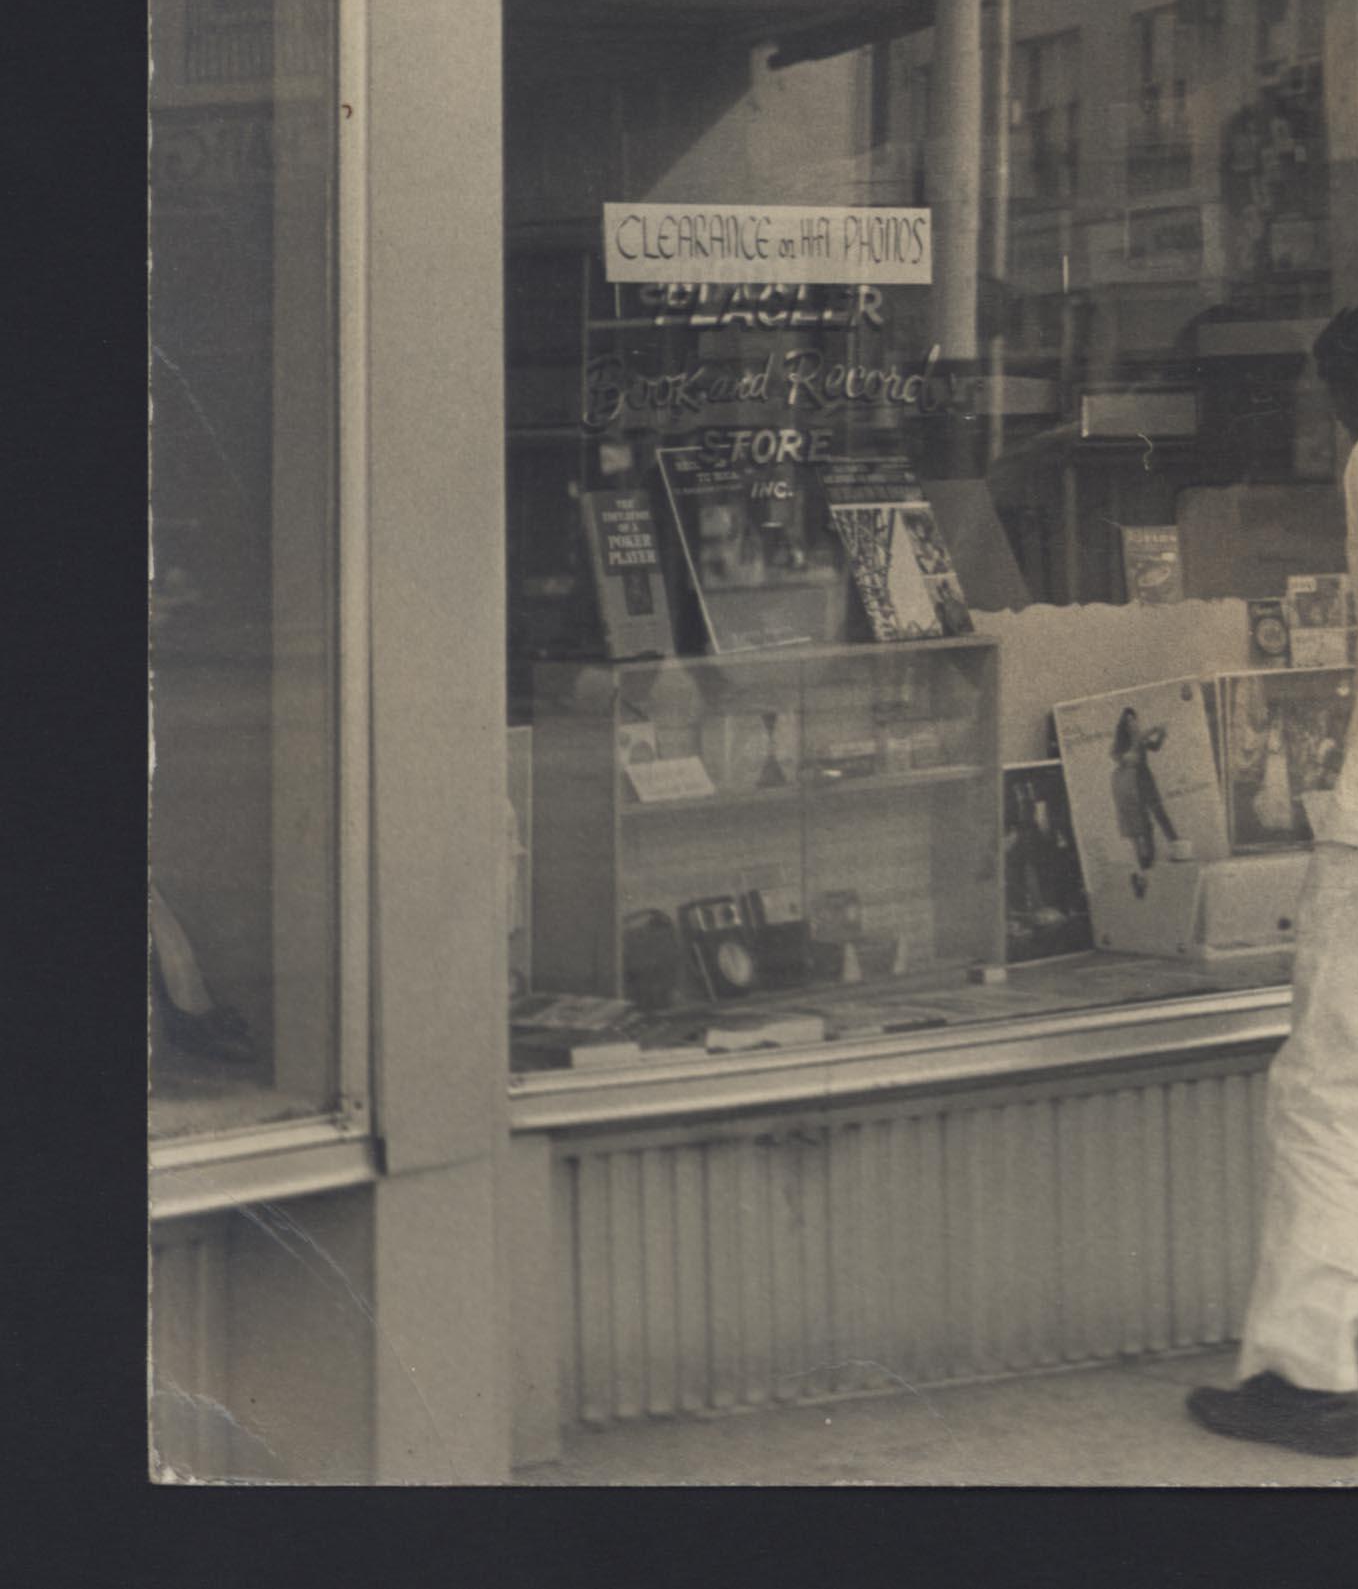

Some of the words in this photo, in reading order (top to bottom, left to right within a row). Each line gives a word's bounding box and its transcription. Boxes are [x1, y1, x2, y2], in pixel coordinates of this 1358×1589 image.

[615, 213, 771, 261] CLEARANCE
[580, 354, 706, 428] Book
[707, 350, 777, 402] and
[782, 342, 940, 414] Record
[703, 427, 834, 464] STORE
[750, 480, 795, 500] INC.
